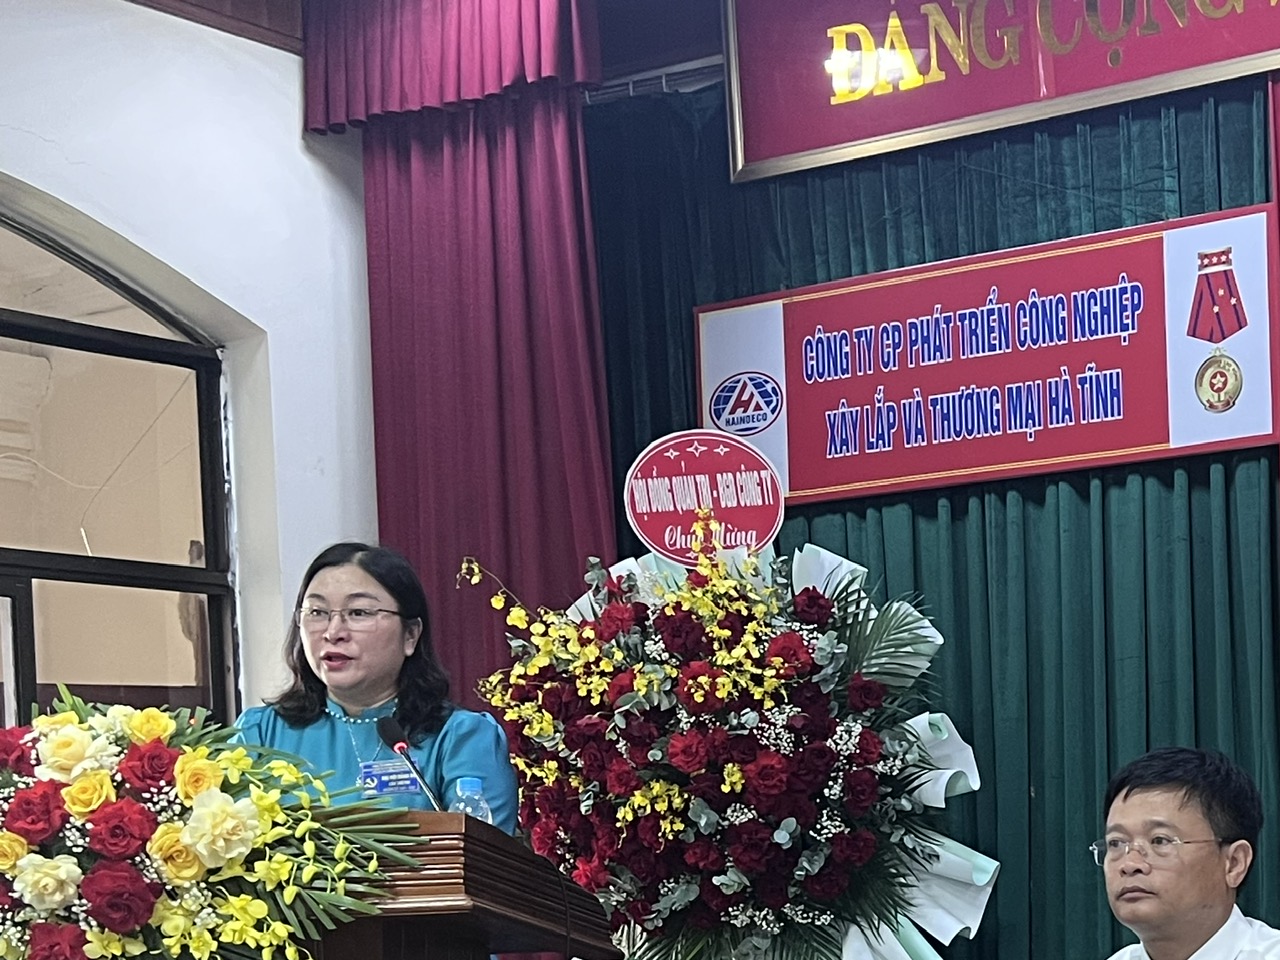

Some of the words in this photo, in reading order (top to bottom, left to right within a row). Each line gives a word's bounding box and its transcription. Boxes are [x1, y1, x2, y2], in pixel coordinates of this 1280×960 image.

[802, 325, 852, 384] CÔNG
[853, 326, 876, 376] TY
[879, 322, 904, 372] CP
[906, 304, 953, 368] PHÁT
[956, 286, 1012, 359] TRIỂN
[1015, 289, 1068, 351] CÔNG
[1071, 272, 1144, 346] NGHIỆP
[725, 412, 768, 427] HAINDECO
[825, 399, 861, 459] XÂY
[864, 386, 898, 453] LẮP
[901, 388, 928, 448] VÀ
[928, 385, 1002, 444] THƯƠNG
[1005, 380, 1044, 442] MẠI
[1047, 366, 1075, 428] HÀ
[1076, 361, 1123, 424] TĨNH
